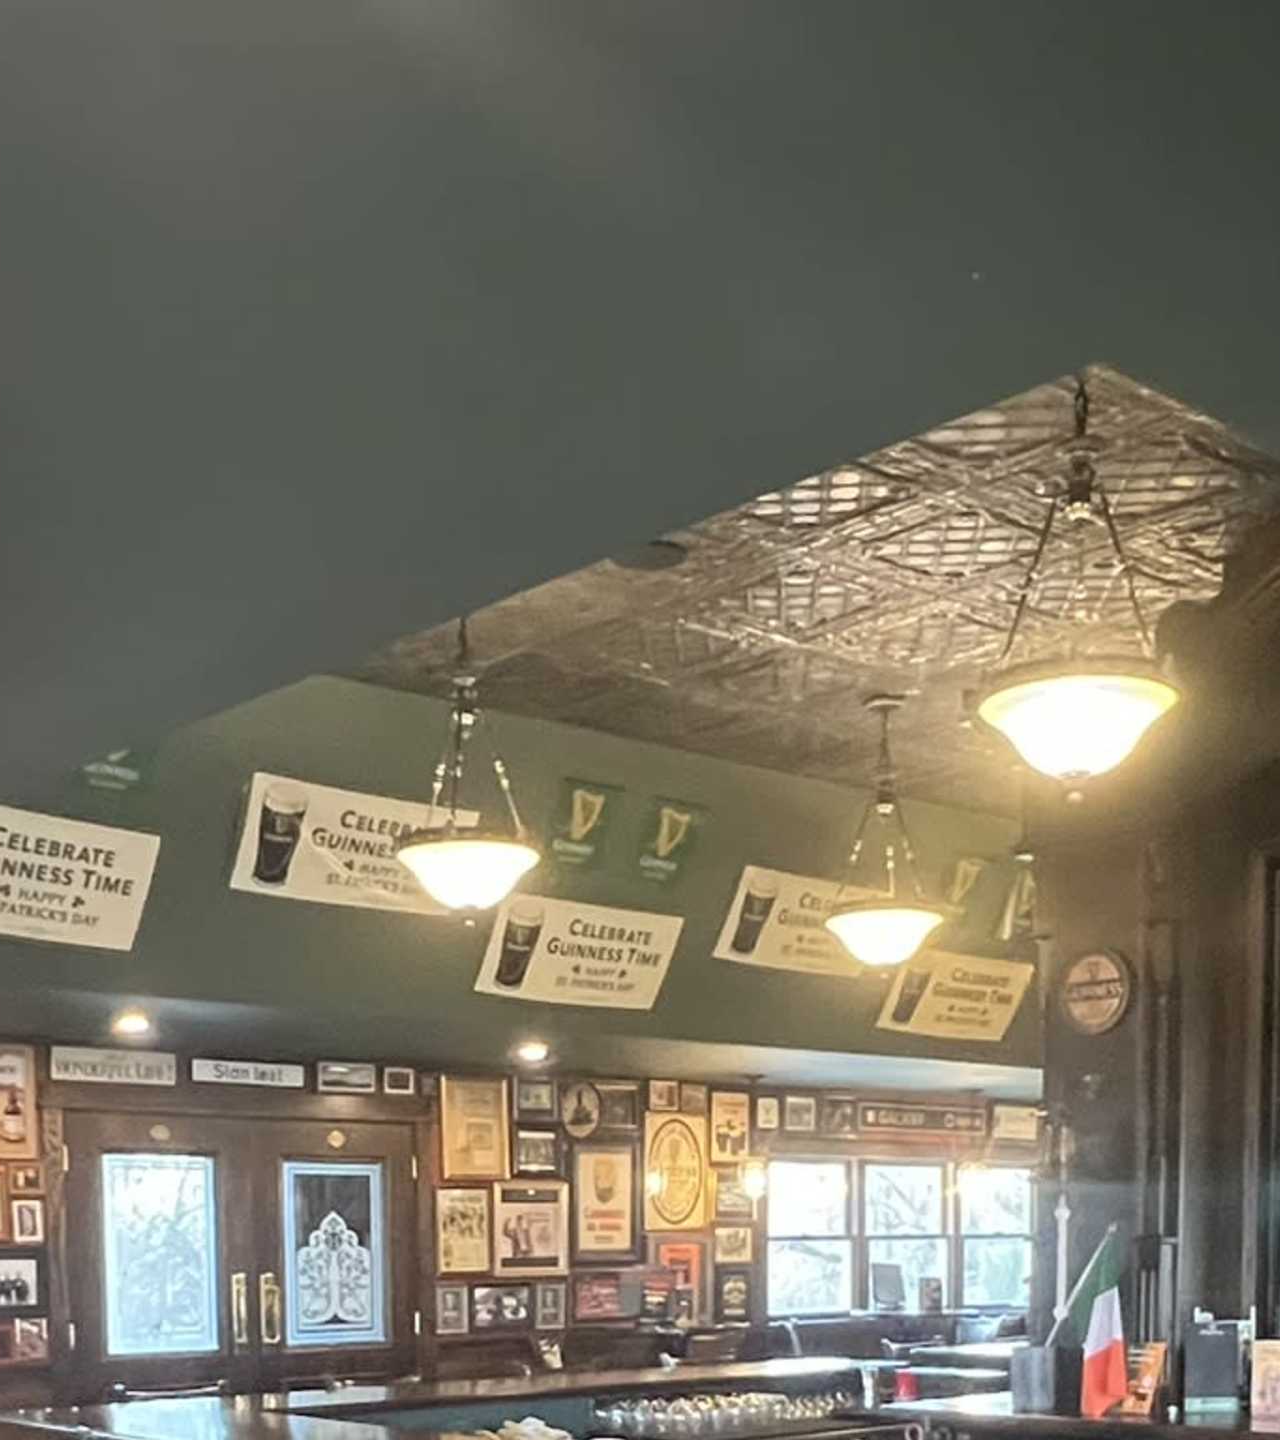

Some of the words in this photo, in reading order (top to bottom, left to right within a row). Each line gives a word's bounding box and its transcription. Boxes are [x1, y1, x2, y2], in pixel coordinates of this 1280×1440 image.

[83, 869, 134, 896] TIME
[18, 887, 67, 906] HAPPY
[0, 901, 68, 922] PATRICK'S
[570, 918, 652, 946] CELEBRATE
[547, 937, 621, 963] GUINNESS
[627, 948, 662, 967] TIME
